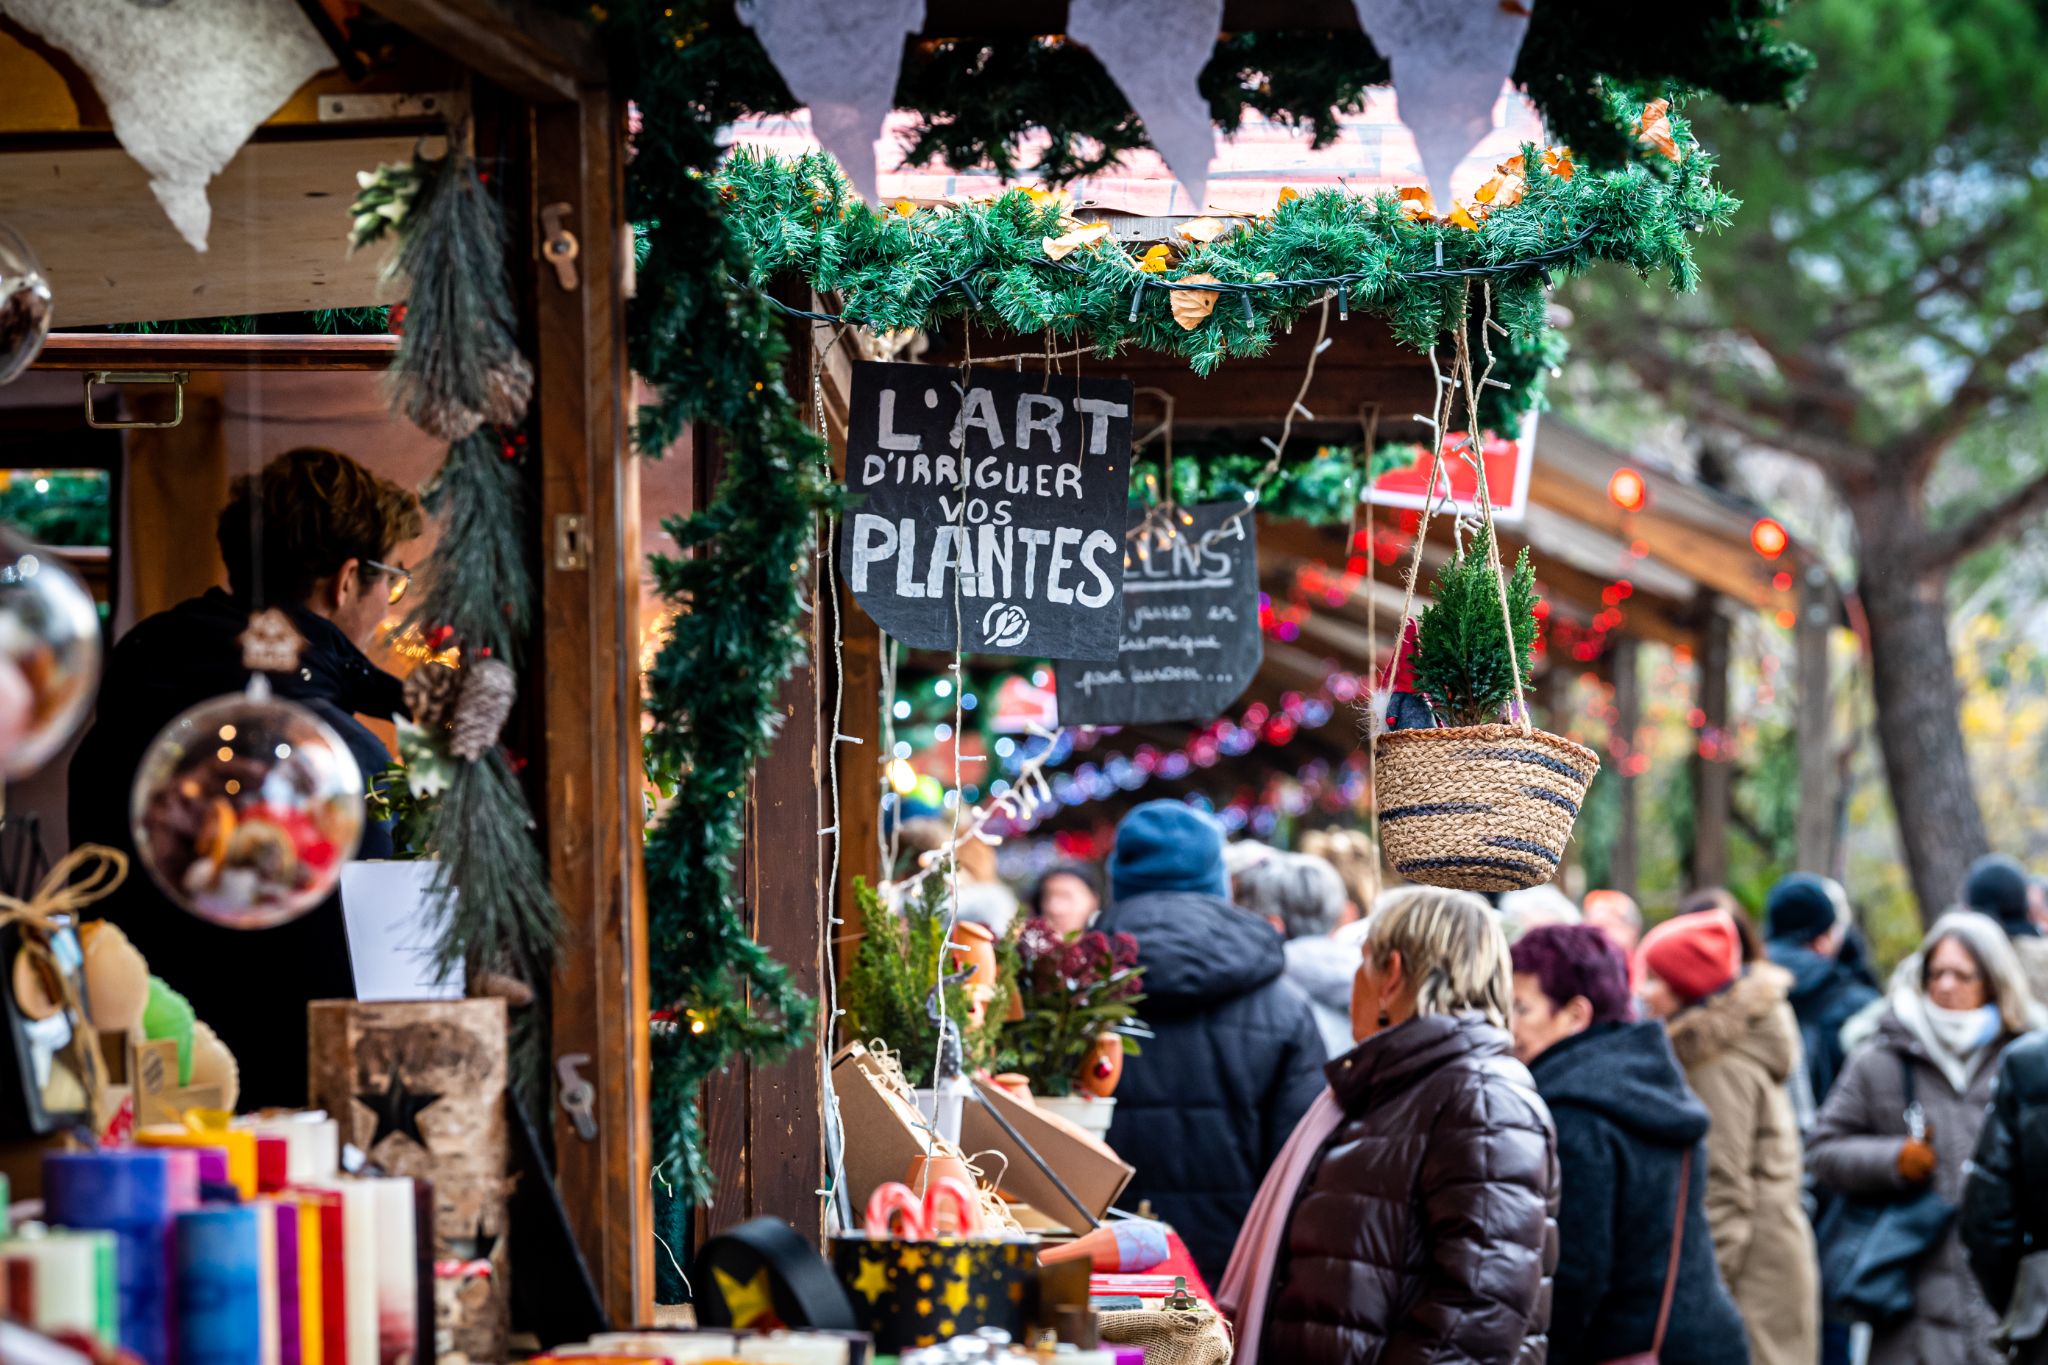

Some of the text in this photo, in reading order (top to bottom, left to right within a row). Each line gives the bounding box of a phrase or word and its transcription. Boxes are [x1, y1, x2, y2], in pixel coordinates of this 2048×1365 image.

[877, 387, 1129, 455] L'ART
[862, 452, 1083, 500] D'IRRIGUER
[938, 495, 1013, 526] VOS
[851, 513, 1118, 609] PLANTES
